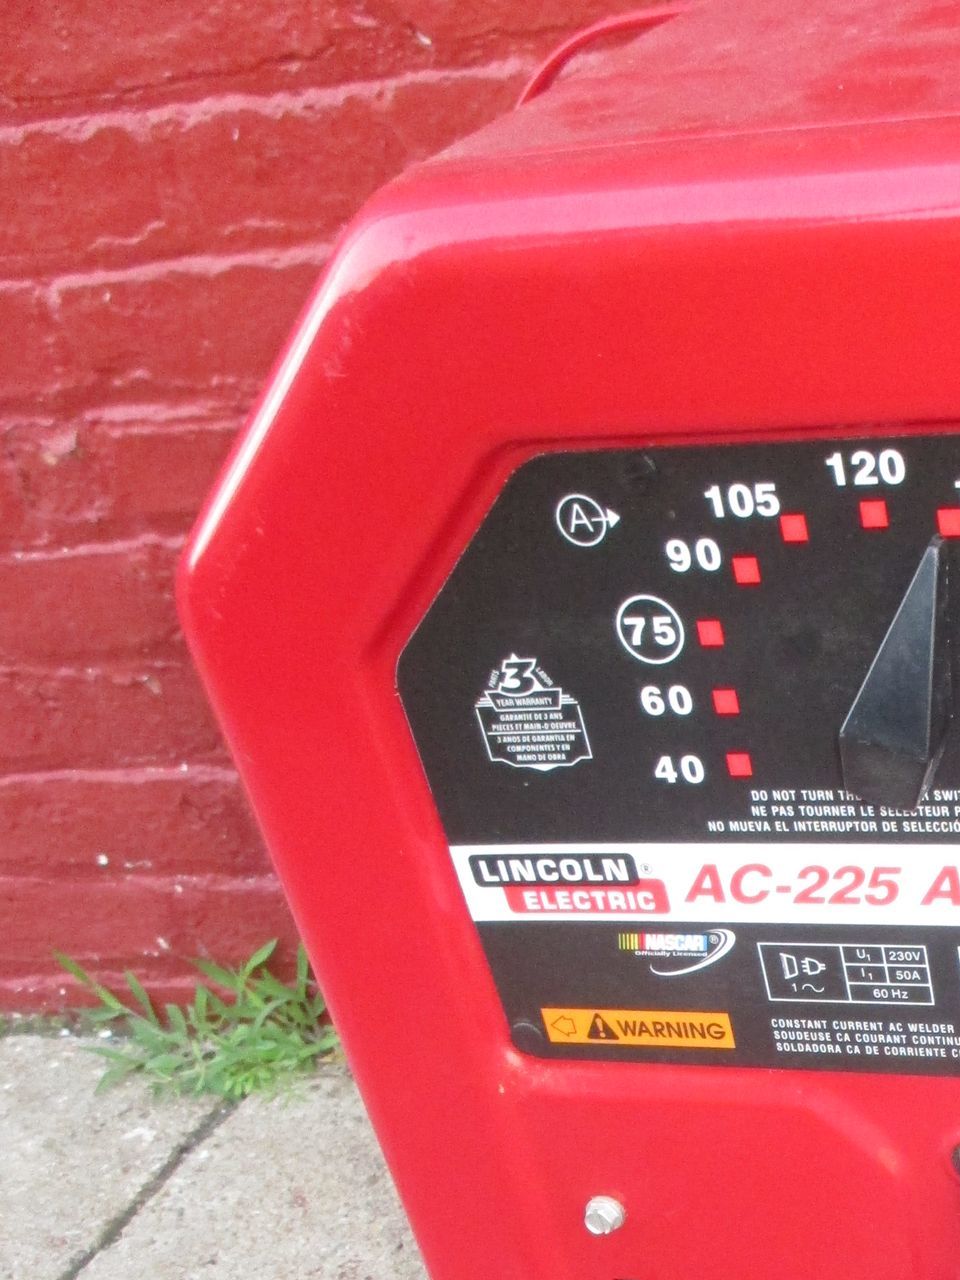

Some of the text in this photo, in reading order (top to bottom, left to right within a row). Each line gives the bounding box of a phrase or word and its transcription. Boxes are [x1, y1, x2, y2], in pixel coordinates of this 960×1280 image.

[826, 449, 905, 485] 120
[704, 483, 780, 517] 105
[666, 538, 721, 572] 90
[622, 616, 674, 648] 75
[499, 661, 535, 695] 3
[495, 697, 553, 707] YEAR WARRANTY
[640, 685, 692, 715] 60
[499, 712, 563, 721] GARANTIE DE ANS
[522, 735, 531, 743] DE
[566, 734, 575, 742] EN
[507, 743, 571, 753] COMPONENTES EN
[516, 753, 567, 762] MANO DE OBRA
[655, 755, 704, 783] 40
[751, 790, 768, 801] DO
[772, 790, 795, 801] NOT
[801, 790, 833, 801] TURN
[751, 806, 767, 816] NE
[771, 806, 794, 816] PAS
[798, 806, 855, 816] TOURNER
[860, 806, 874, 816] LE
[708, 821, 724, 831] NO
[729, 821, 771, 831] MUEVA
[775, 821, 789, 831] EL
[794, 821, 877, 832] INTERRUPTOR
[882, 822, 898, 832] DE
[477, 858, 630, 883] LINCOLN
[686, 864, 901, 905] AC-225
[522, 890, 657, 911] ELECTRIC
[645, 934, 705, 951] NASCAR
[635, 950, 671, 958] Officially
[889, 951, 920, 961] 230V
[896, 971, 920, 980] 50A
[873, 989, 908, 999] 60 Hz
[617, 1021, 725, 1039] WARNING
[771, 1019, 954, 1033] CONSTANT CURRENT AC WELDER
[774, 1031, 960, 1045] SOUDEUSE CA COURANT CONTINU
[776, 1042, 841, 1053] SOLDADORA
[846, 1045, 860, 1054] CA
[865, 1046, 879, 1054] DE
[884, 1046, 946, 1057] CORRIENTE
